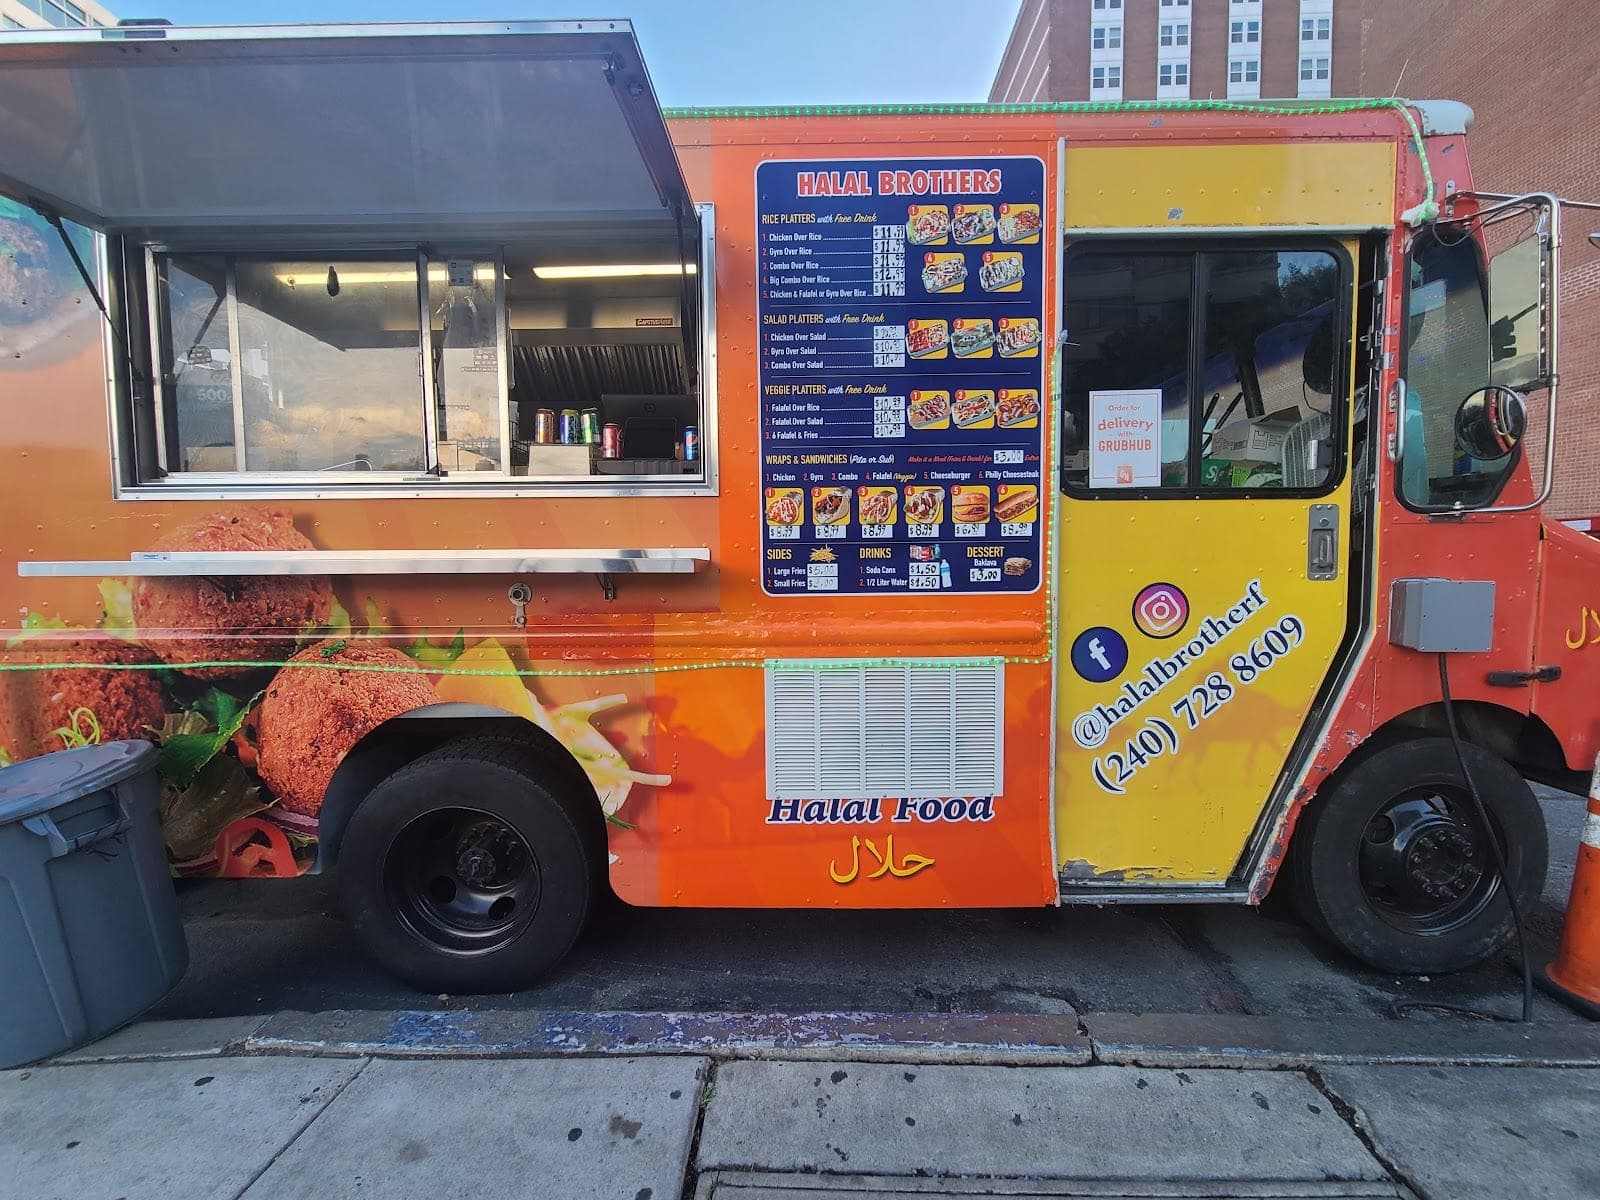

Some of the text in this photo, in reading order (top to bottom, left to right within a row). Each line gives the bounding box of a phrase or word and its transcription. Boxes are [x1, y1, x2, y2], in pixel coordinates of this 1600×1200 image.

[798, 169, 1002, 196] HALAL BROTHERS
[762, 212, 878, 224] RICE PLATTERS with Free Drink
[769, 233, 792, 241] Chicken
[809, 232, 822, 241] Rice
[770, 248, 783, 257] Gyro
[800, 247, 812, 255] Rice
[770, 262, 790, 270] Combo
[806, 261, 819, 269] Rice
[770, 276, 780, 286] Big
[781, 276, 800, 284] Combo
[817, 275, 830, 283] Rice
[770, 290, 792, 298] Chicken
[799, 290, 818, 298] Falafel
[826, 290, 839, 299] Gyro
[840, 289, 853, 297] Over
[764, 313, 885, 324] SALAD PLATTERS with Free Drink
[770, 333, 794, 341] Chicken
[810, 332, 826, 340] Salad
[770, 348, 784, 357] Gyro
[800, 347, 816, 355] Salad
[765, 384, 887, 394] VEGGIE PLATTERS with Free Drink
[1098, 417, 1153, 431] delivery
[1099, 440, 1151, 452] GRUBHUB
[766, 455, 792, 464] WRAPS
[793, 455, 799, 464] &
[801, 454, 847, 464] SANDWICHES
[850, 454, 867, 464] (Pita
[878, 454, 895, 464] Sub)
[773, 473, 796, 481] Chicken
[810, 473, 823, 482] Gyro
[930, 472, 971, 480] Cheeseburger
[986, 470, 1001, 480] Philly
[1003, 470, 1039, 478] Cheesesteak
[767, 549, 792, 559] SIDES
[860, 548, 892, 558] DRINKS
[967, 546, 1005, 557] DESSERT
[774, 568, 790, 576] Large
[910, 564, 936, 574] $1.50
[910, 577, 936, 588] $1.50
[1074, 579, 1266, 747] @halalbrotherf
[1093, 616, 1304, 792] (240) 728 8609
[766, 796, 994, 824] Halal Food
[829, 834, 935, 884] حلال
